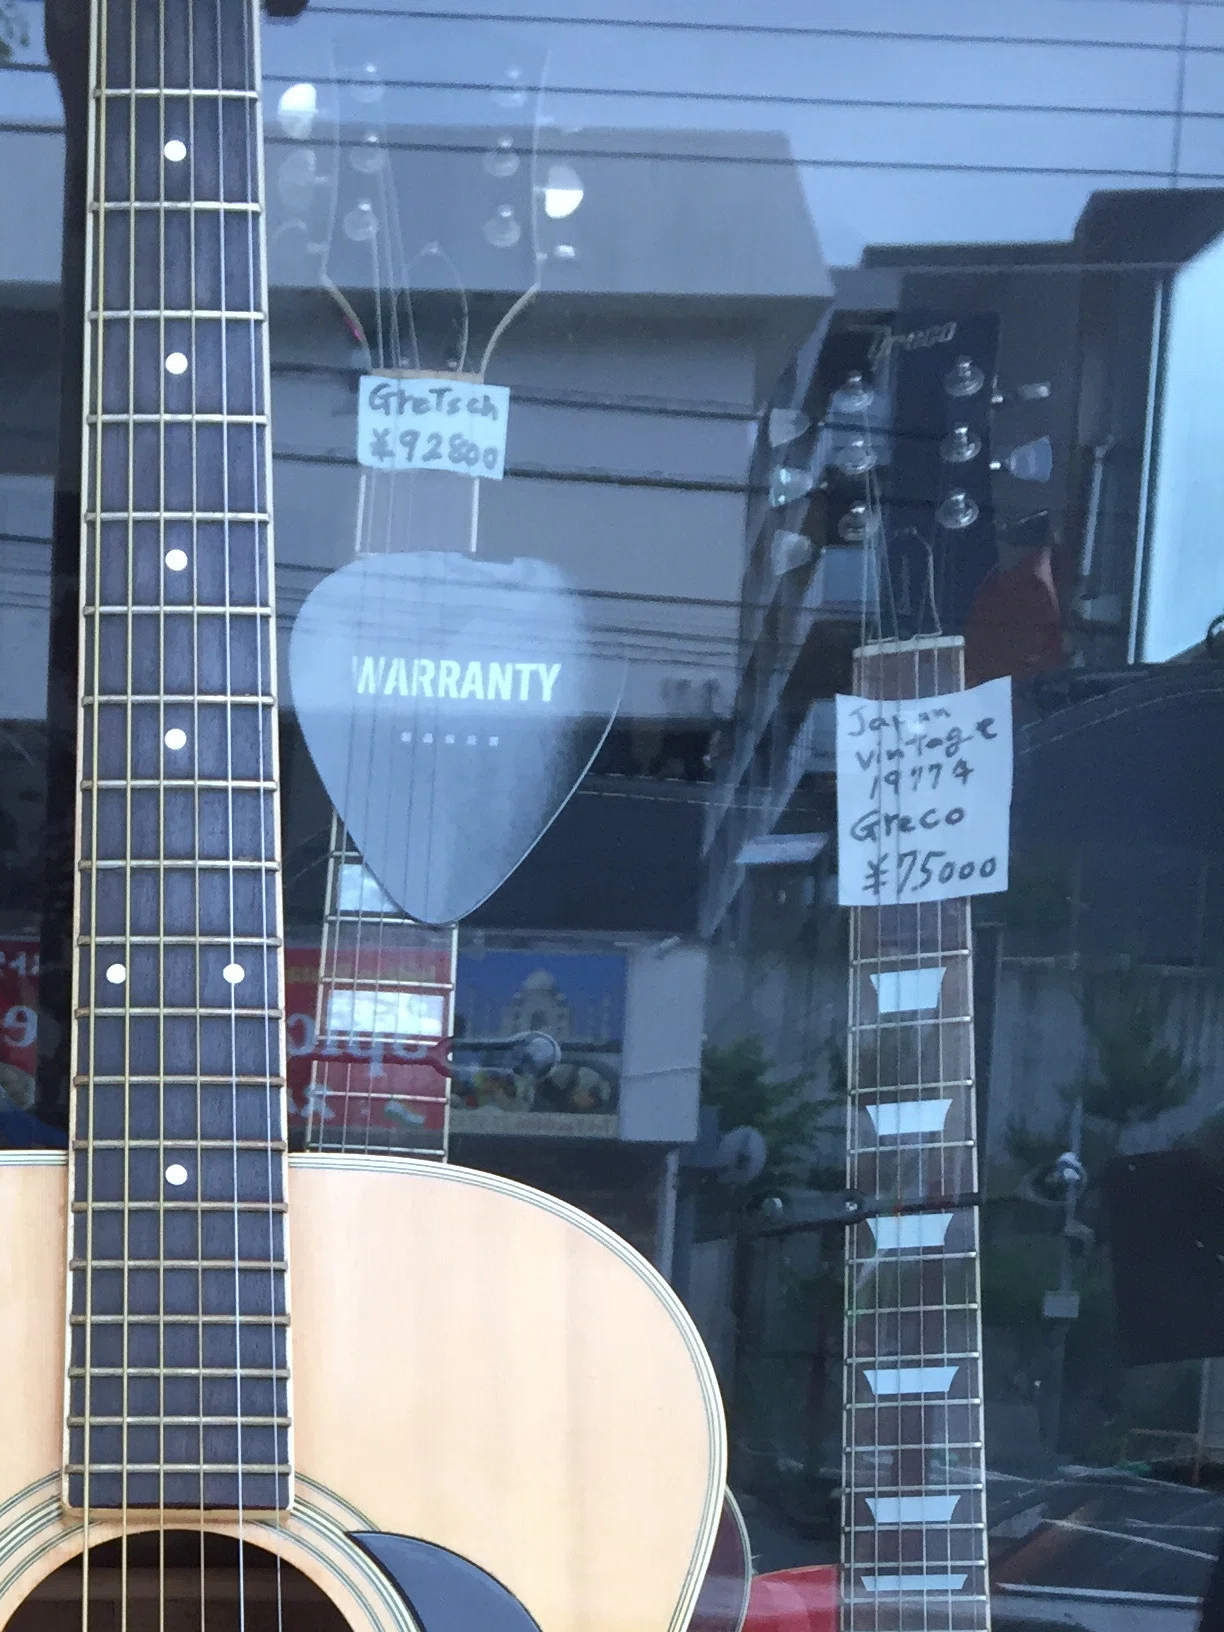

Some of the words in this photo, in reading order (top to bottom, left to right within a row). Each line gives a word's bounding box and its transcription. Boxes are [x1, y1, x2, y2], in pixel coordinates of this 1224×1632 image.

[369, 427, 498, 471] ¥92800
[352, 655, 562, 702] WARRANTY
[849, 807, 965, 843] Greco
[862, 849, 997, 896] ¥75000
